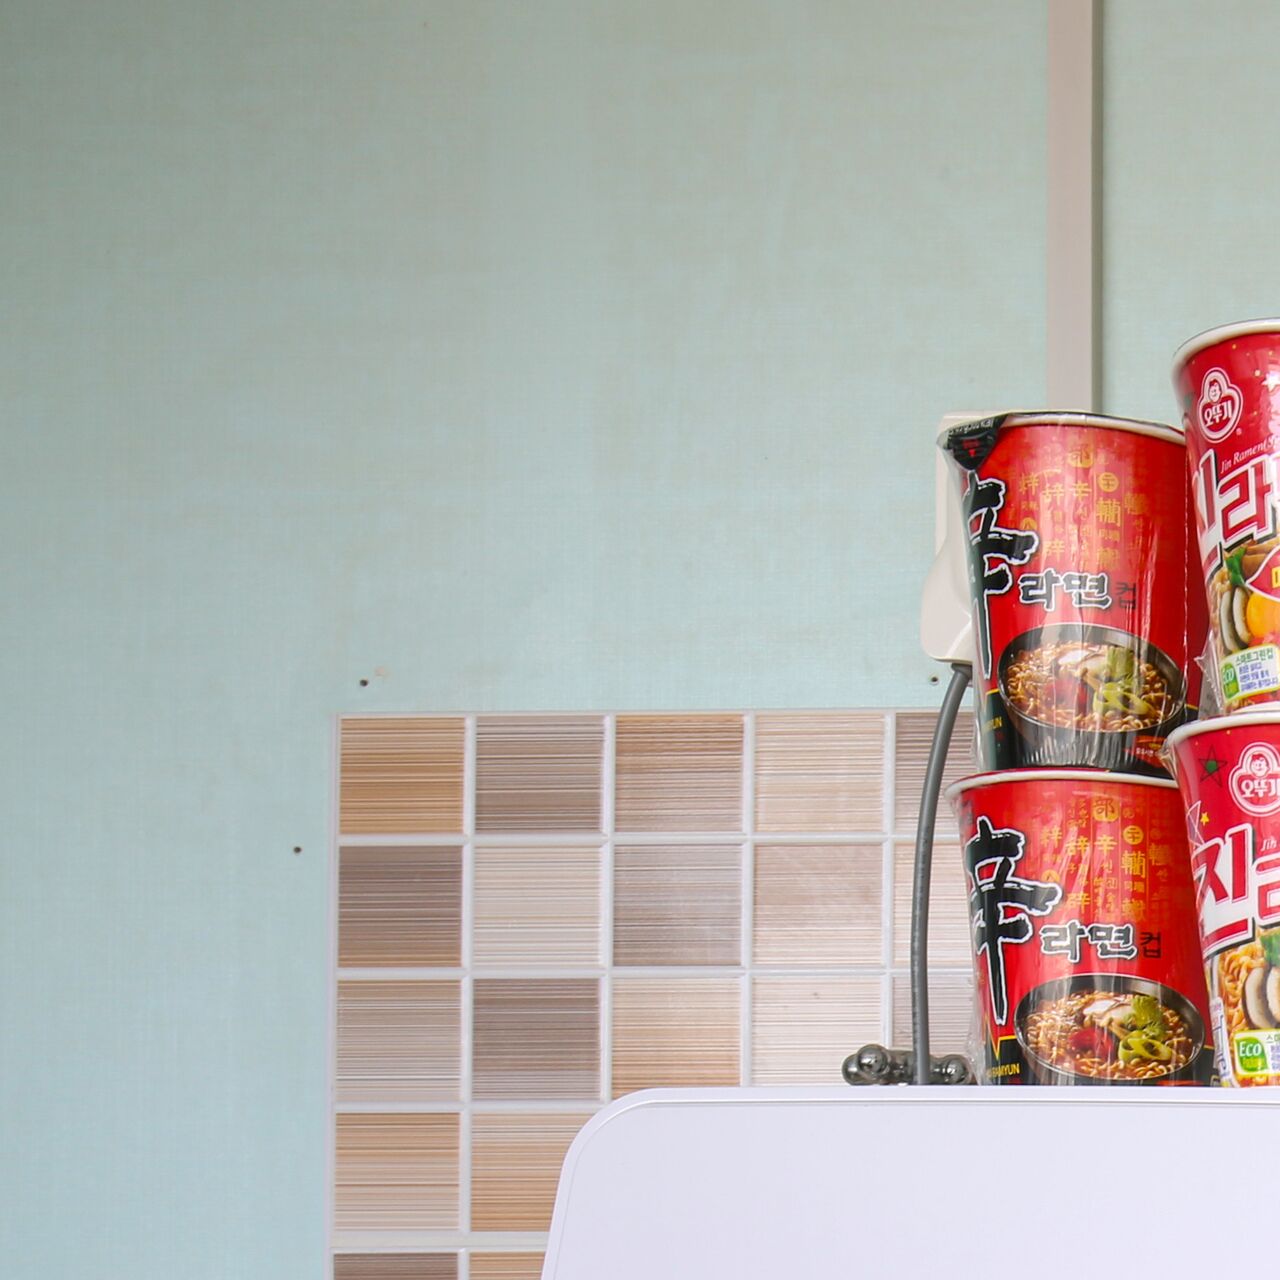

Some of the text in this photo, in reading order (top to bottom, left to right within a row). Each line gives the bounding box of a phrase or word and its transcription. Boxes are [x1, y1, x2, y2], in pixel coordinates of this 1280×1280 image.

[1203, 399, 1233, 429] 오뚜기
[1018, 566, 1138, 612] 라면 컵
[1039, 919, 1163, 963] 라면 컵
